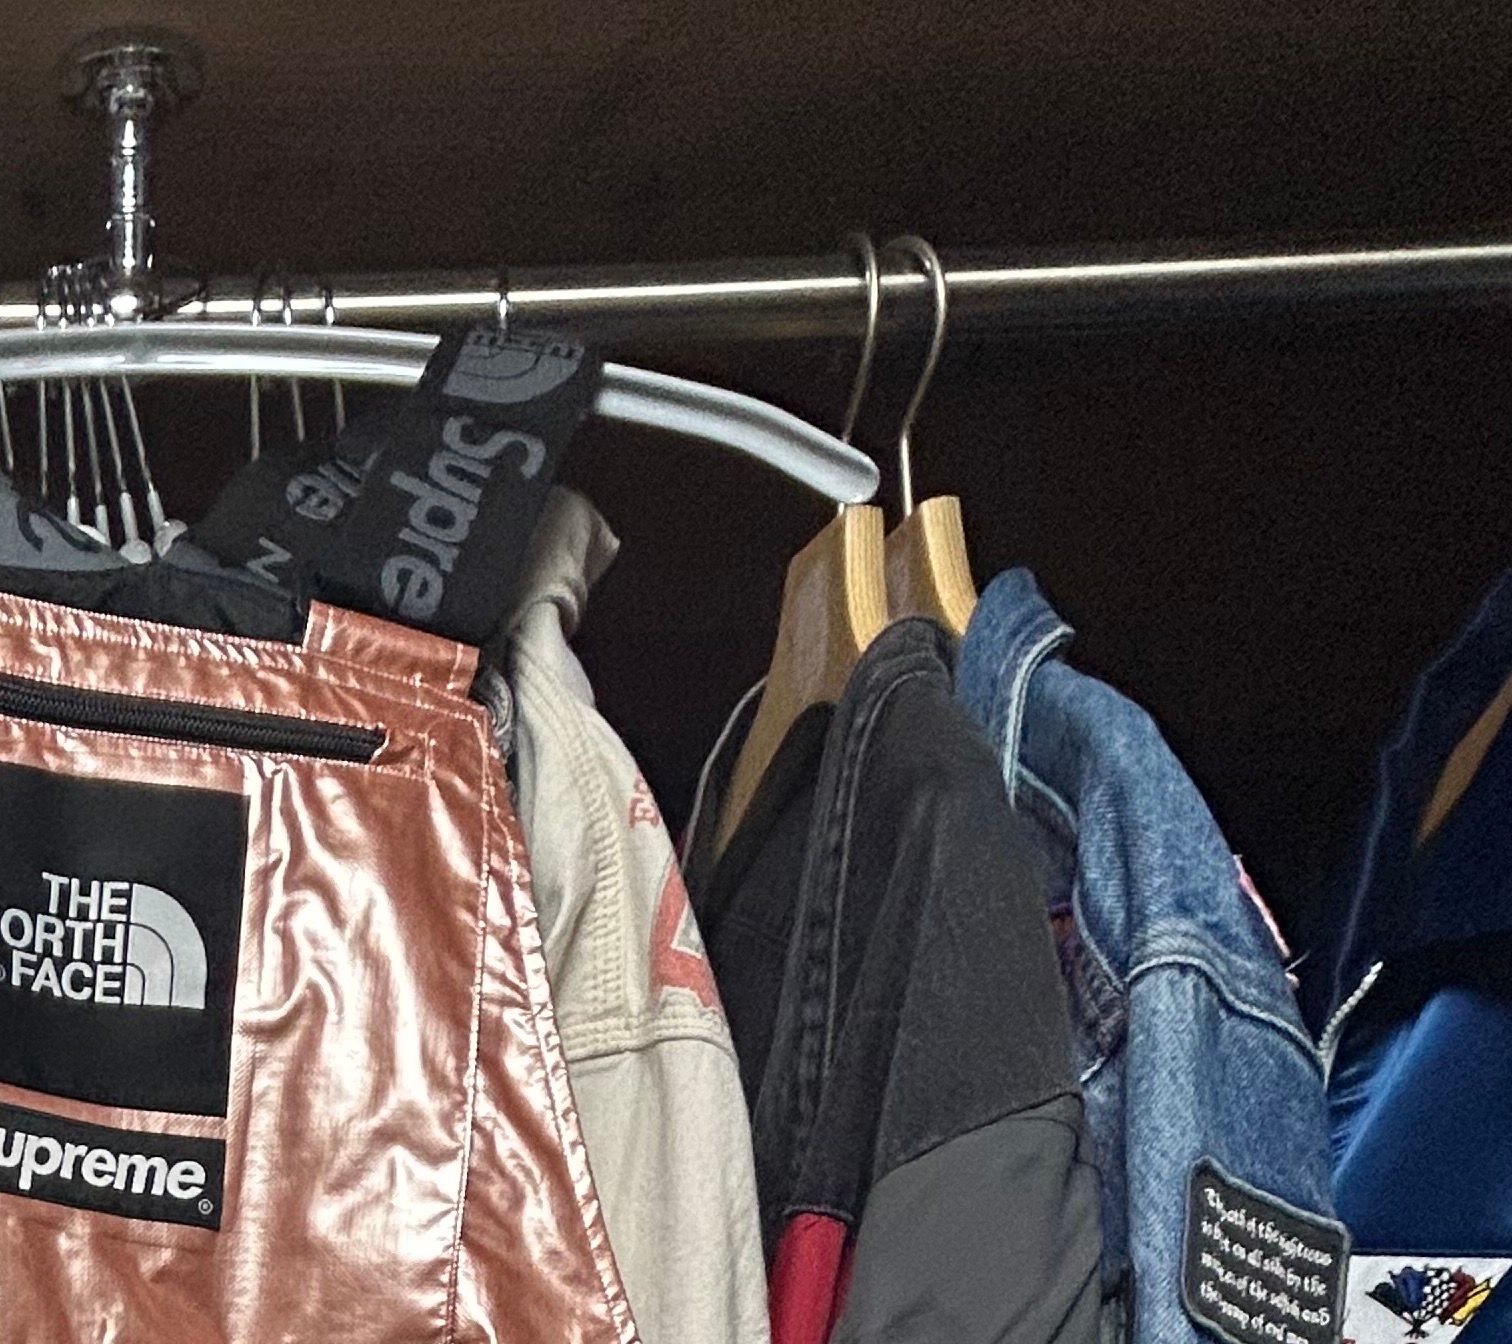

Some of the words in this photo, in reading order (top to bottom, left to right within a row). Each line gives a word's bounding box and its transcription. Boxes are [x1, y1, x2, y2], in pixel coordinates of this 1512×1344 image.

[381, 415, 546, 619] Supre
[42, 872, 130, 922] THE
[12, 950, 125, 1004] FACE
